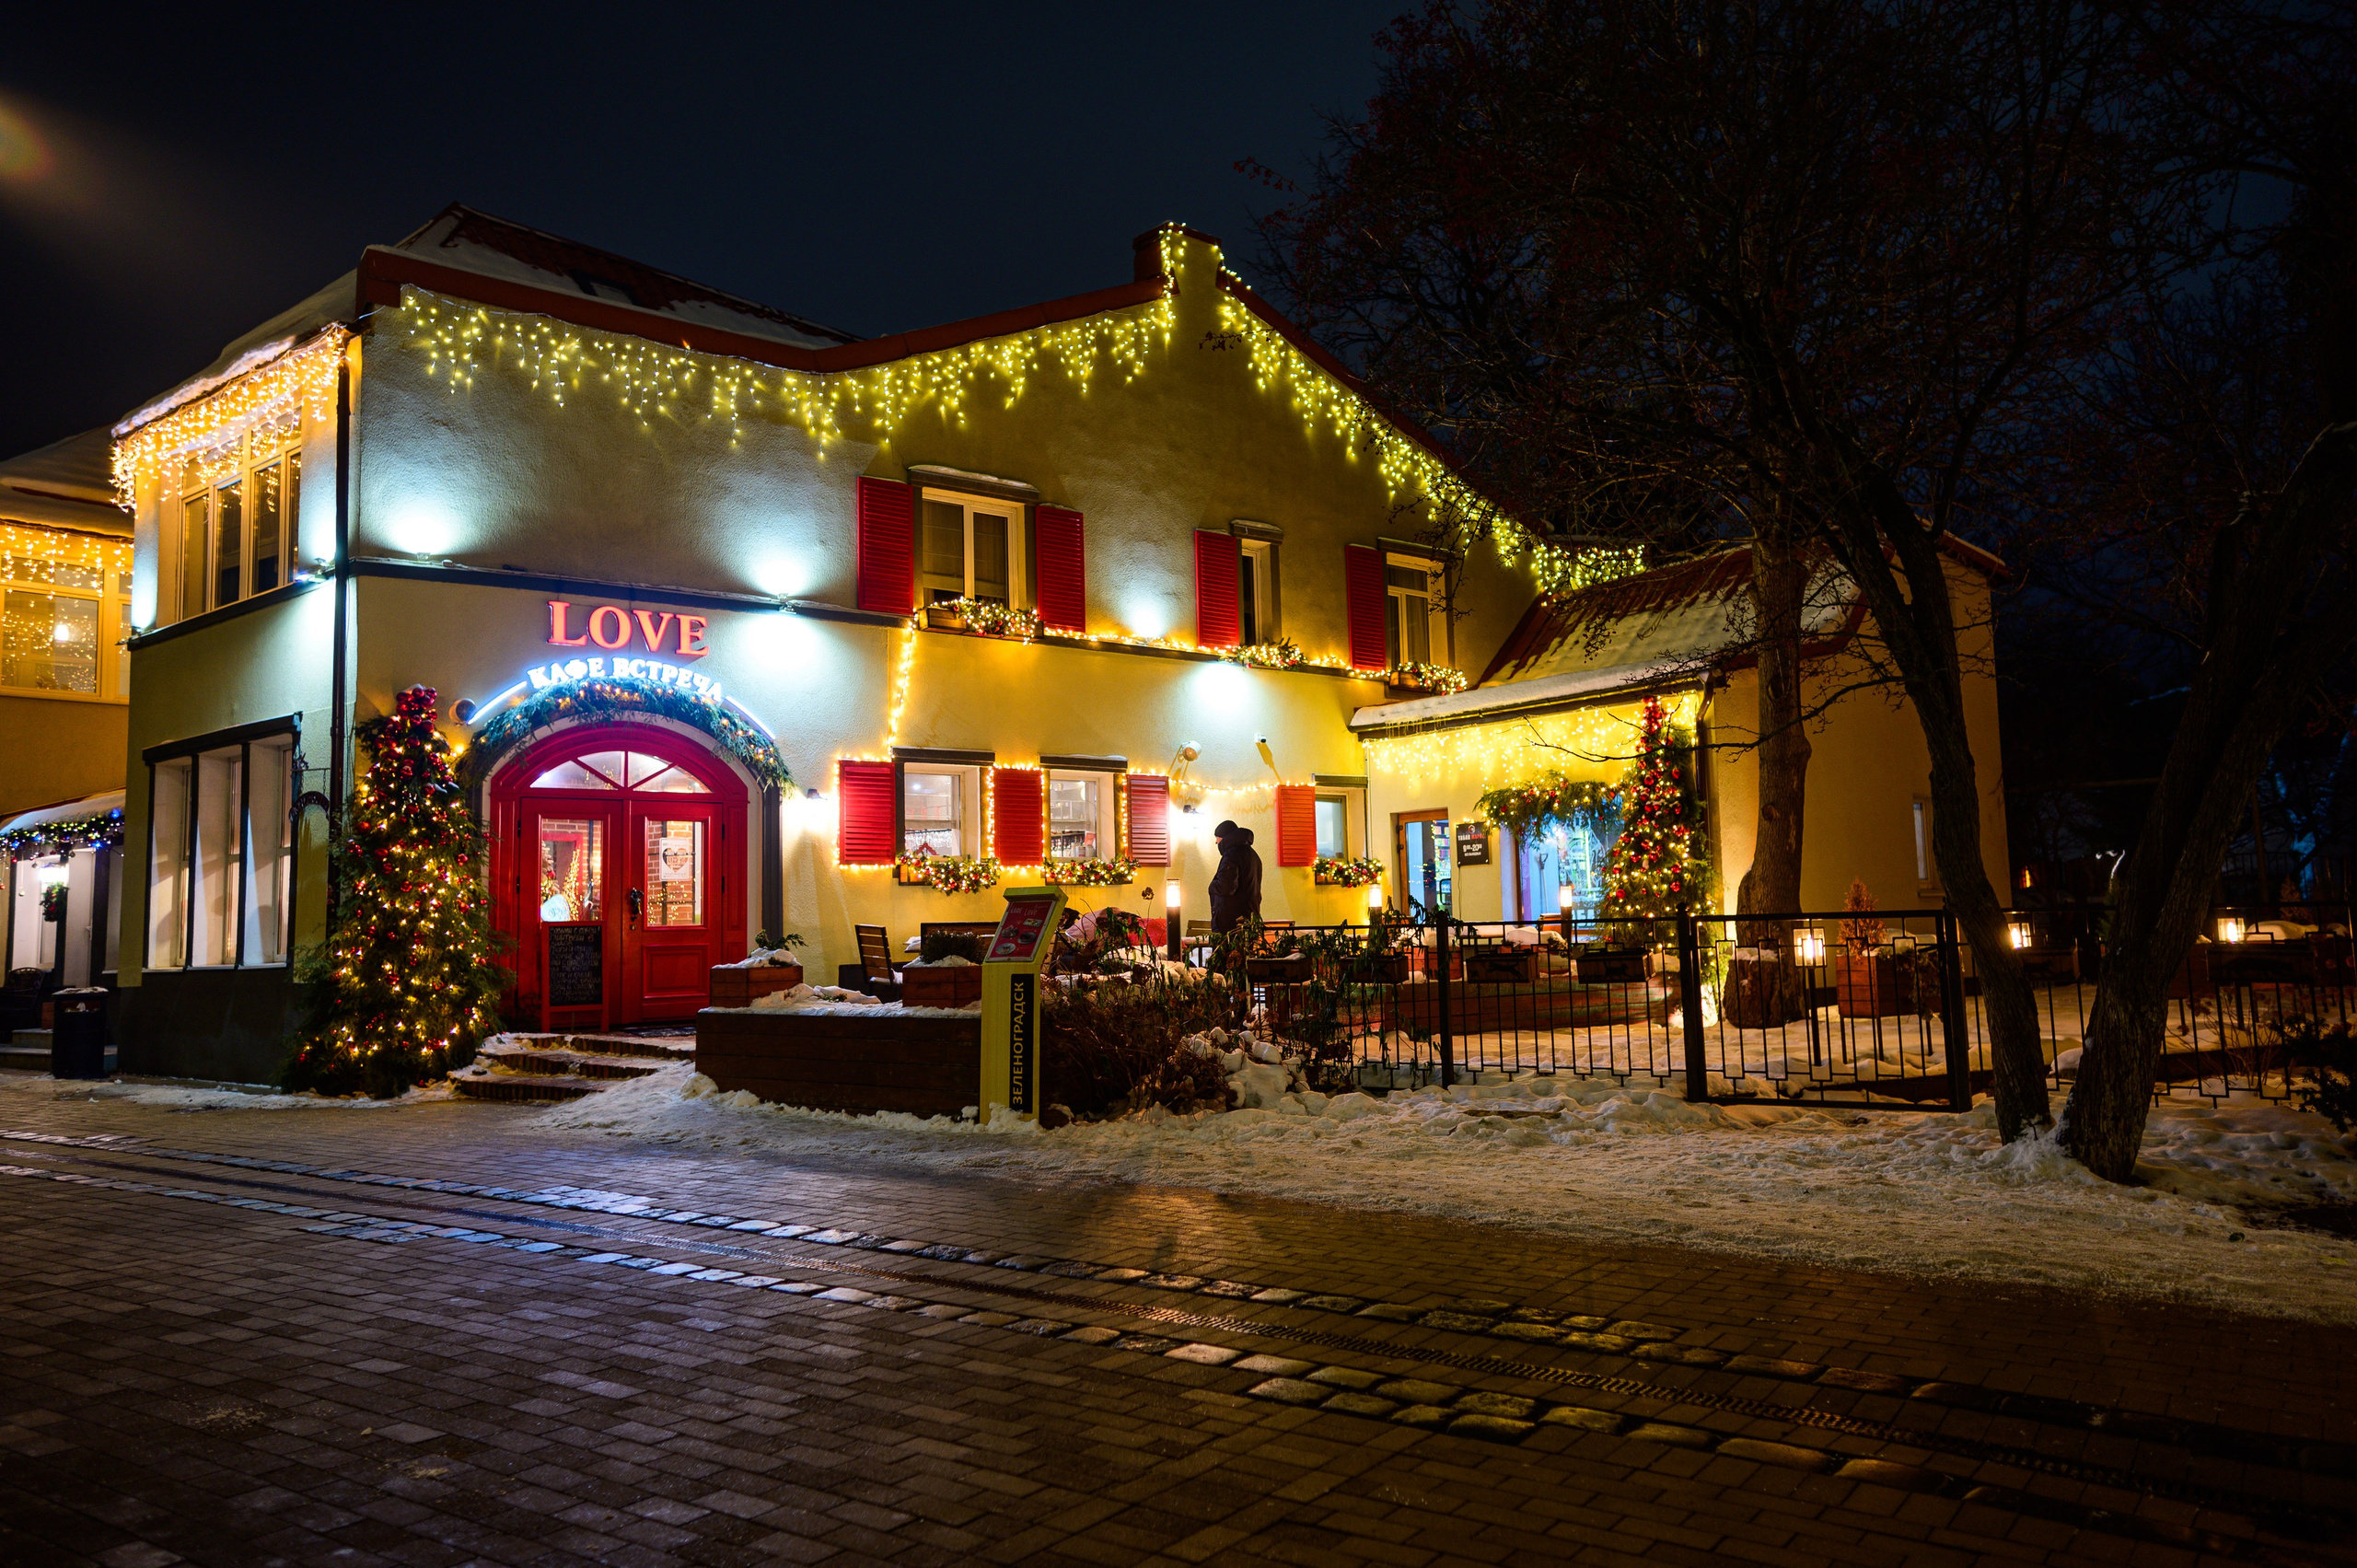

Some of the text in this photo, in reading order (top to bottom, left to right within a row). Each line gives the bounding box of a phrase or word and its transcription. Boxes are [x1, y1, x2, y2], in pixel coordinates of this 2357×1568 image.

[547, 600, 710, 656] LOVE
[528, 657, 723, 702] КАФЕ ВСТРЕЧА
[1013, 981, 1027, 1105] ЗЕЛЕНОГРАДСК
